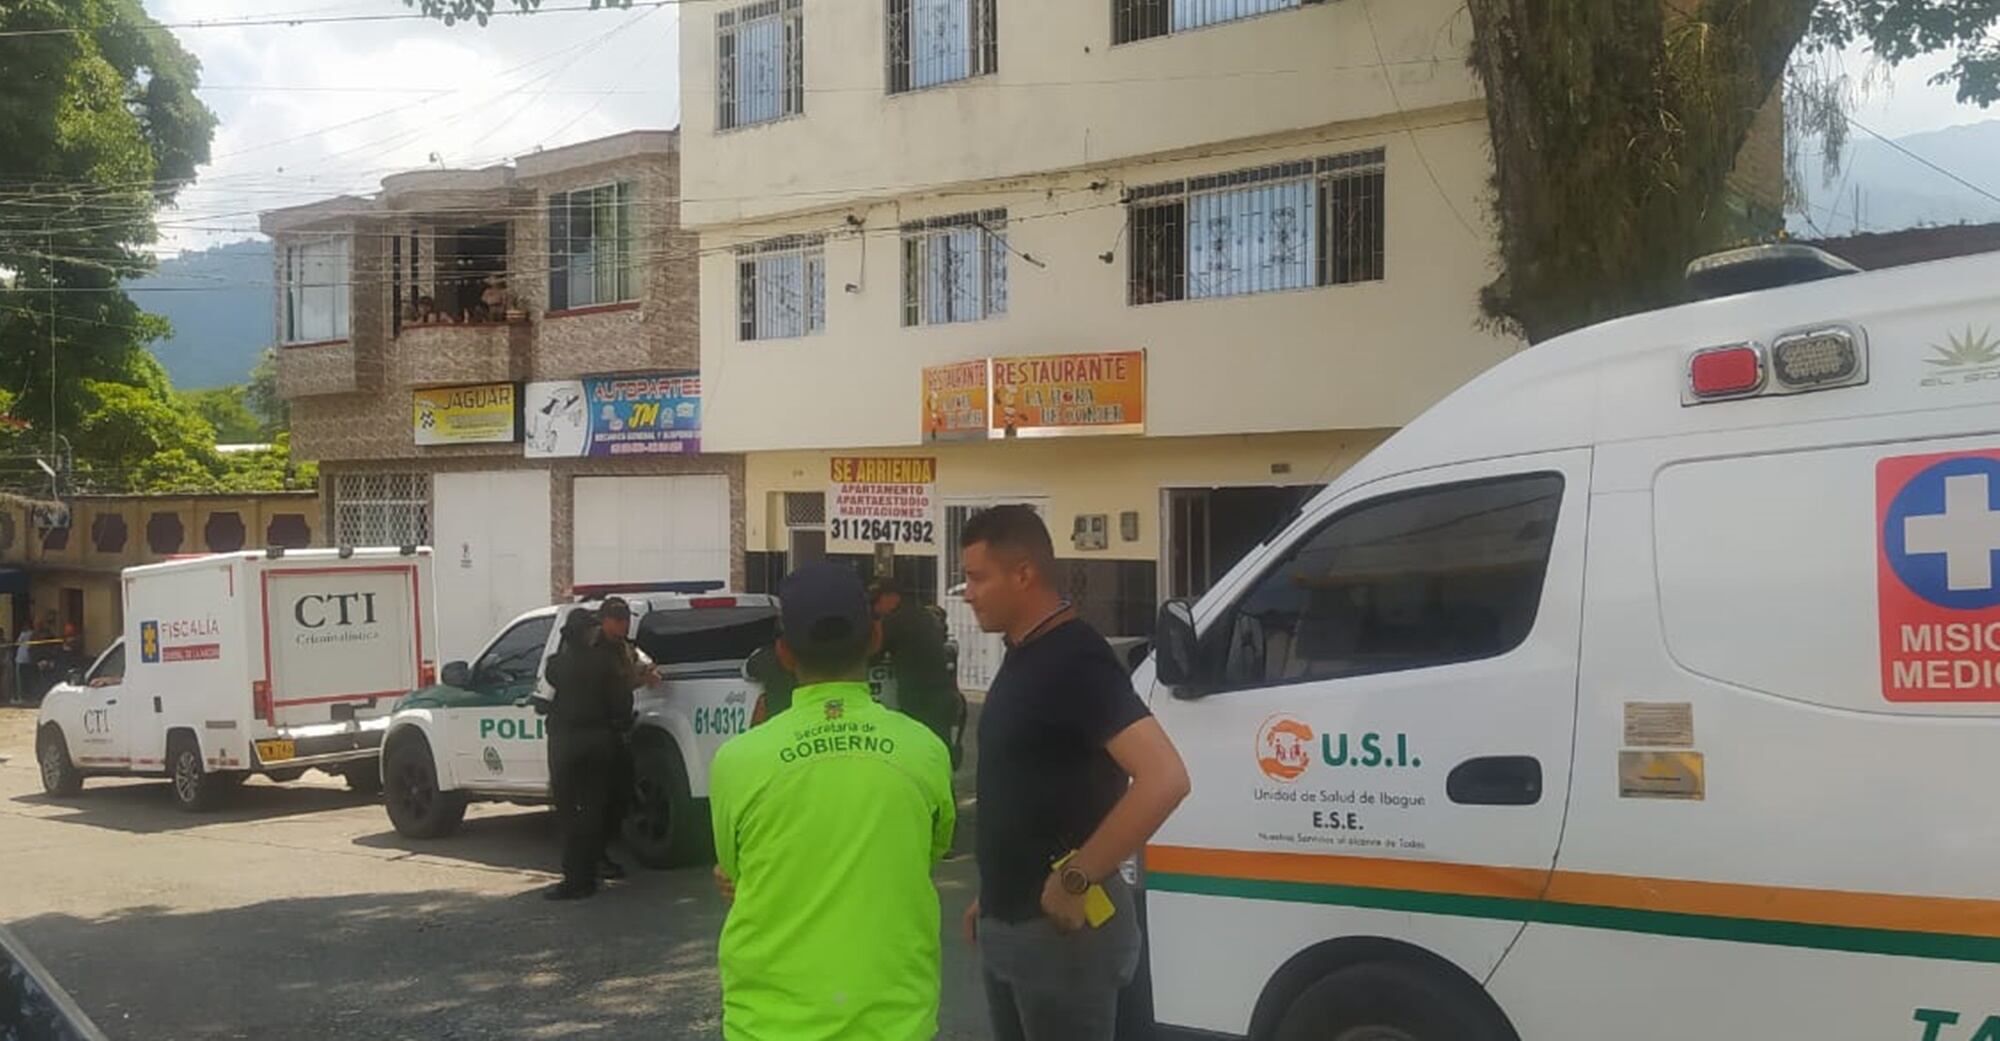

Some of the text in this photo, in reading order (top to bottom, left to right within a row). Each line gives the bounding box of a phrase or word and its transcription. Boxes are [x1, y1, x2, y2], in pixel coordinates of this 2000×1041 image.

[995, 357, 1126, 385] RESTAURANTE
[444, 387, 511, 410] JAGUAR
[594, 377, 702, 401] AUTOPARTES
[1025, 389, 1043, 405] LA
[833, 459, 931, 483] SE ARRIENDA
[837, 495, 929, 507] APARTAESTUDIO
[841, 485, 924, 495] APARTAMENTO
[840, 506, 924, 518] HABITACIONES
[831, 518, 933, 543] 3112647392
[295, 592, 377, 628] CTI
[1892, 659, 2000, 689] MEDI
[84, 709, 110, 735] CTI
[695, 707, 746, 735] 61-0312
[780, 735, 895, 763] GOBIERNO
[1322, 732, 1422, 767] U.S.I.
[1254, 788, 1297, 802] Unidad
[1301, 790, 1316, 802] de
[1319, 790, 1355, 803] Salud
[1359, 791, 1375, 804] de
[1312, 811, 1364, 830] E.S.E.
